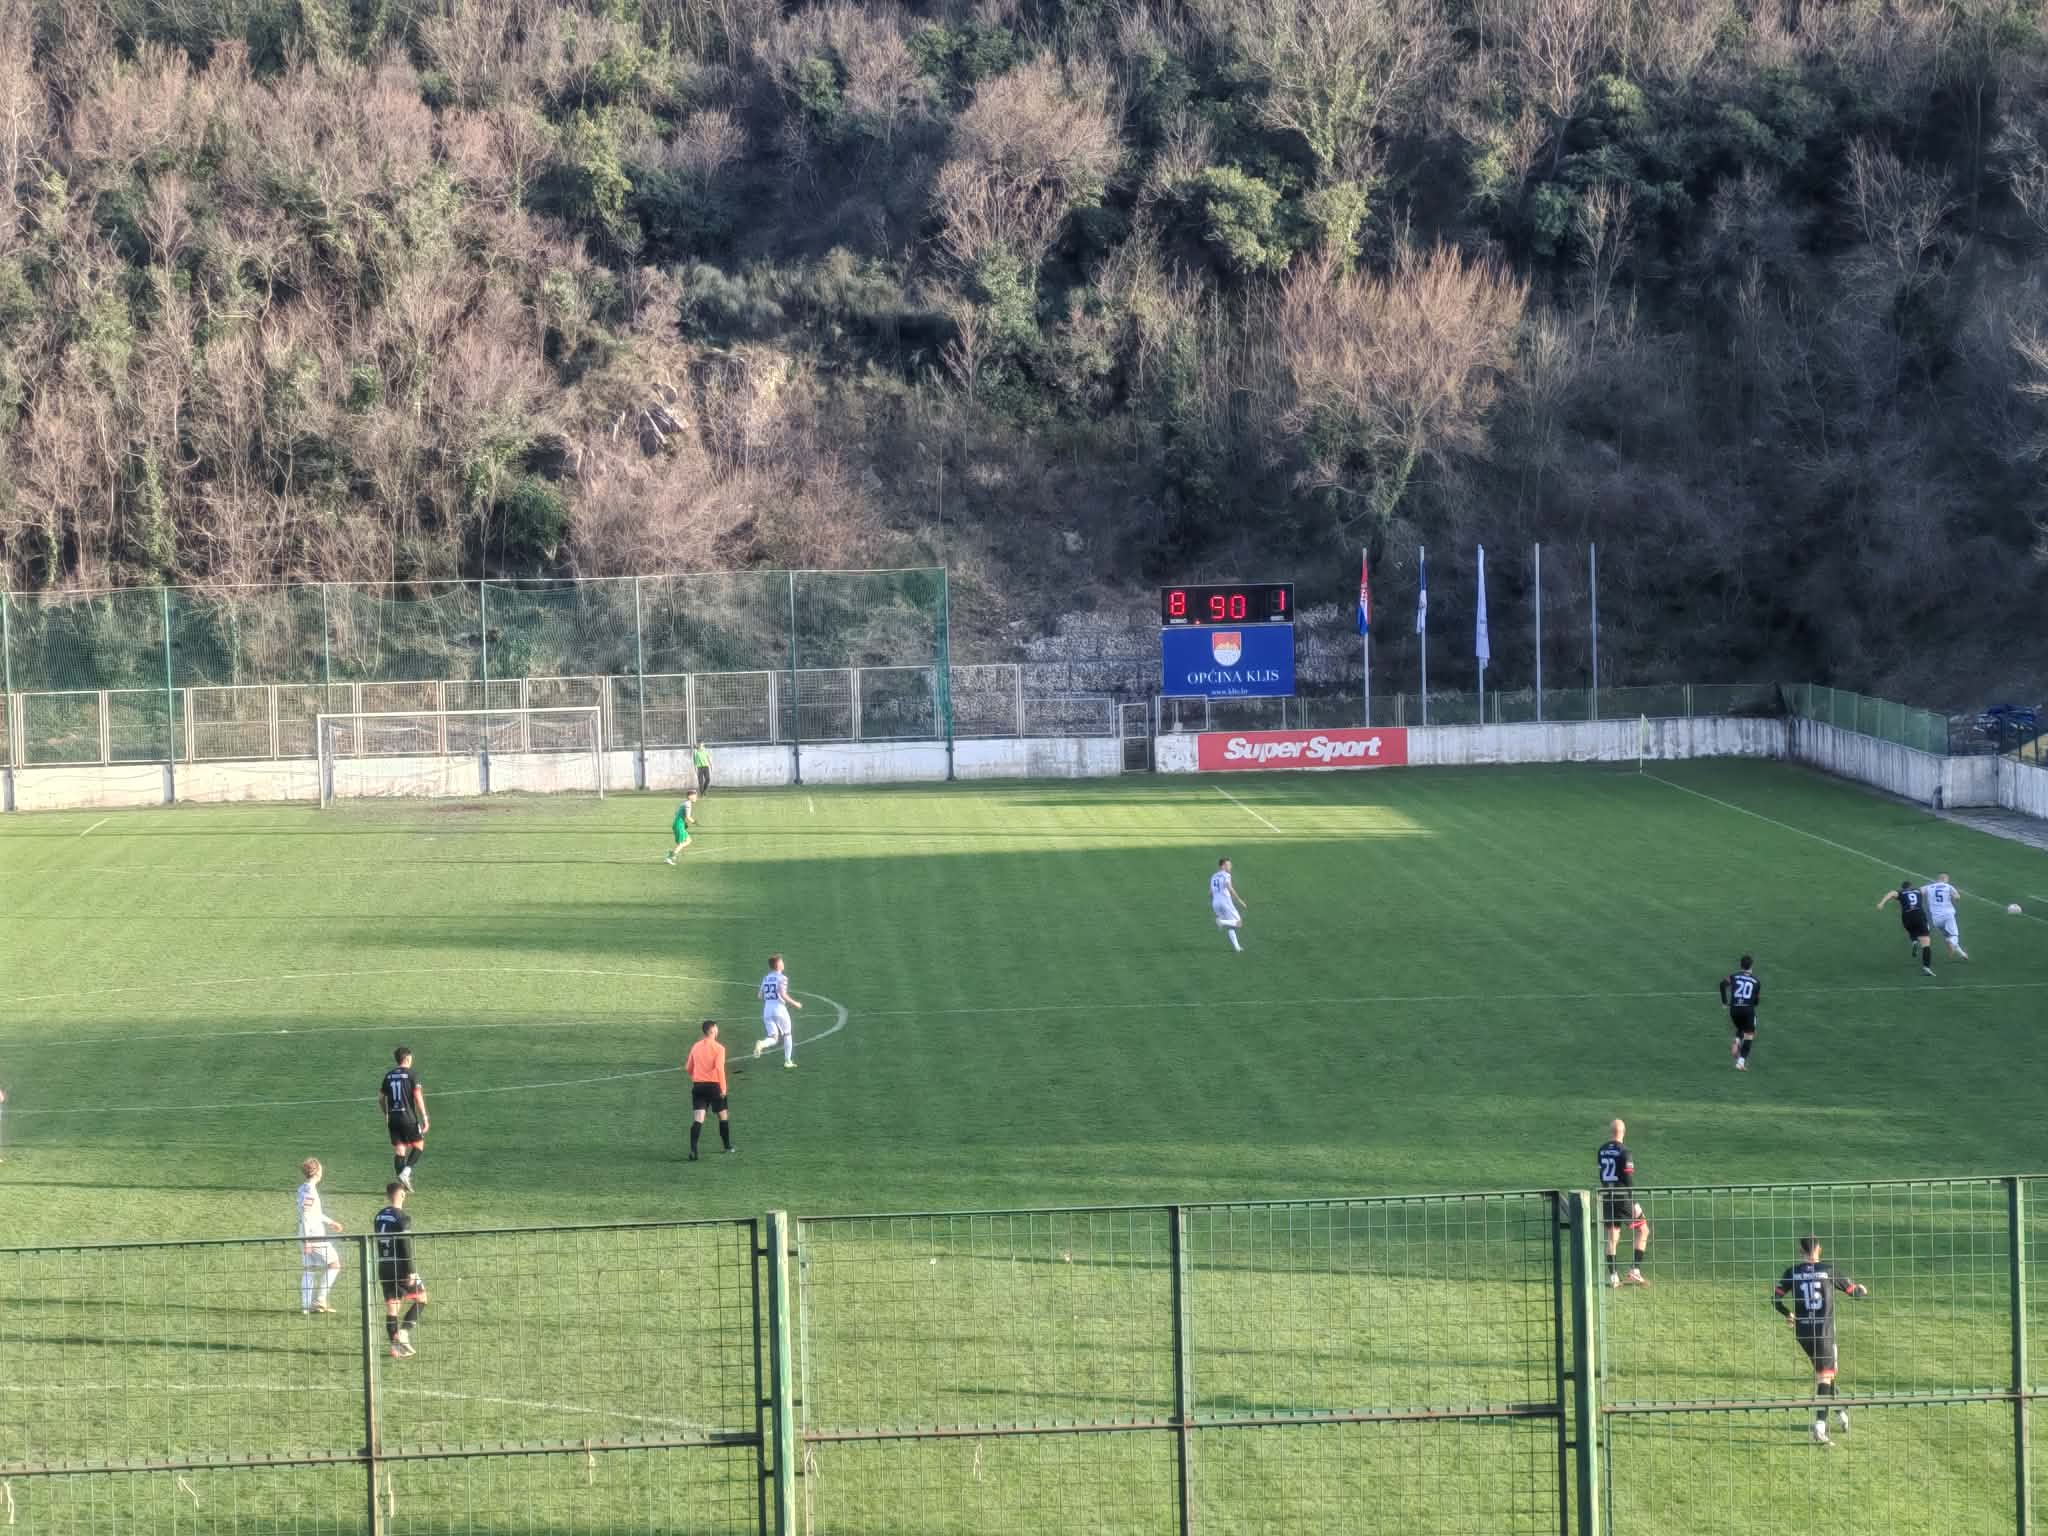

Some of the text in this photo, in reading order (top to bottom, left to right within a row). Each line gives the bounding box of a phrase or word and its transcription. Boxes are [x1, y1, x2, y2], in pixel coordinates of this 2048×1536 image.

[1169, 590, 1285, 620] 8 90 1
[1187, 669, 1280, 684] OPĆINA KLIS
[1907, 893, 1918, 906] 9
[1935, 889, 1944, 903] 5
[1734, 980, 1753, 999] 20
[390, 1081, 401, 1101] 11
[1601, 1158, 1619, 1181] 22
[1800, 1281, 1823, 1311] 15
